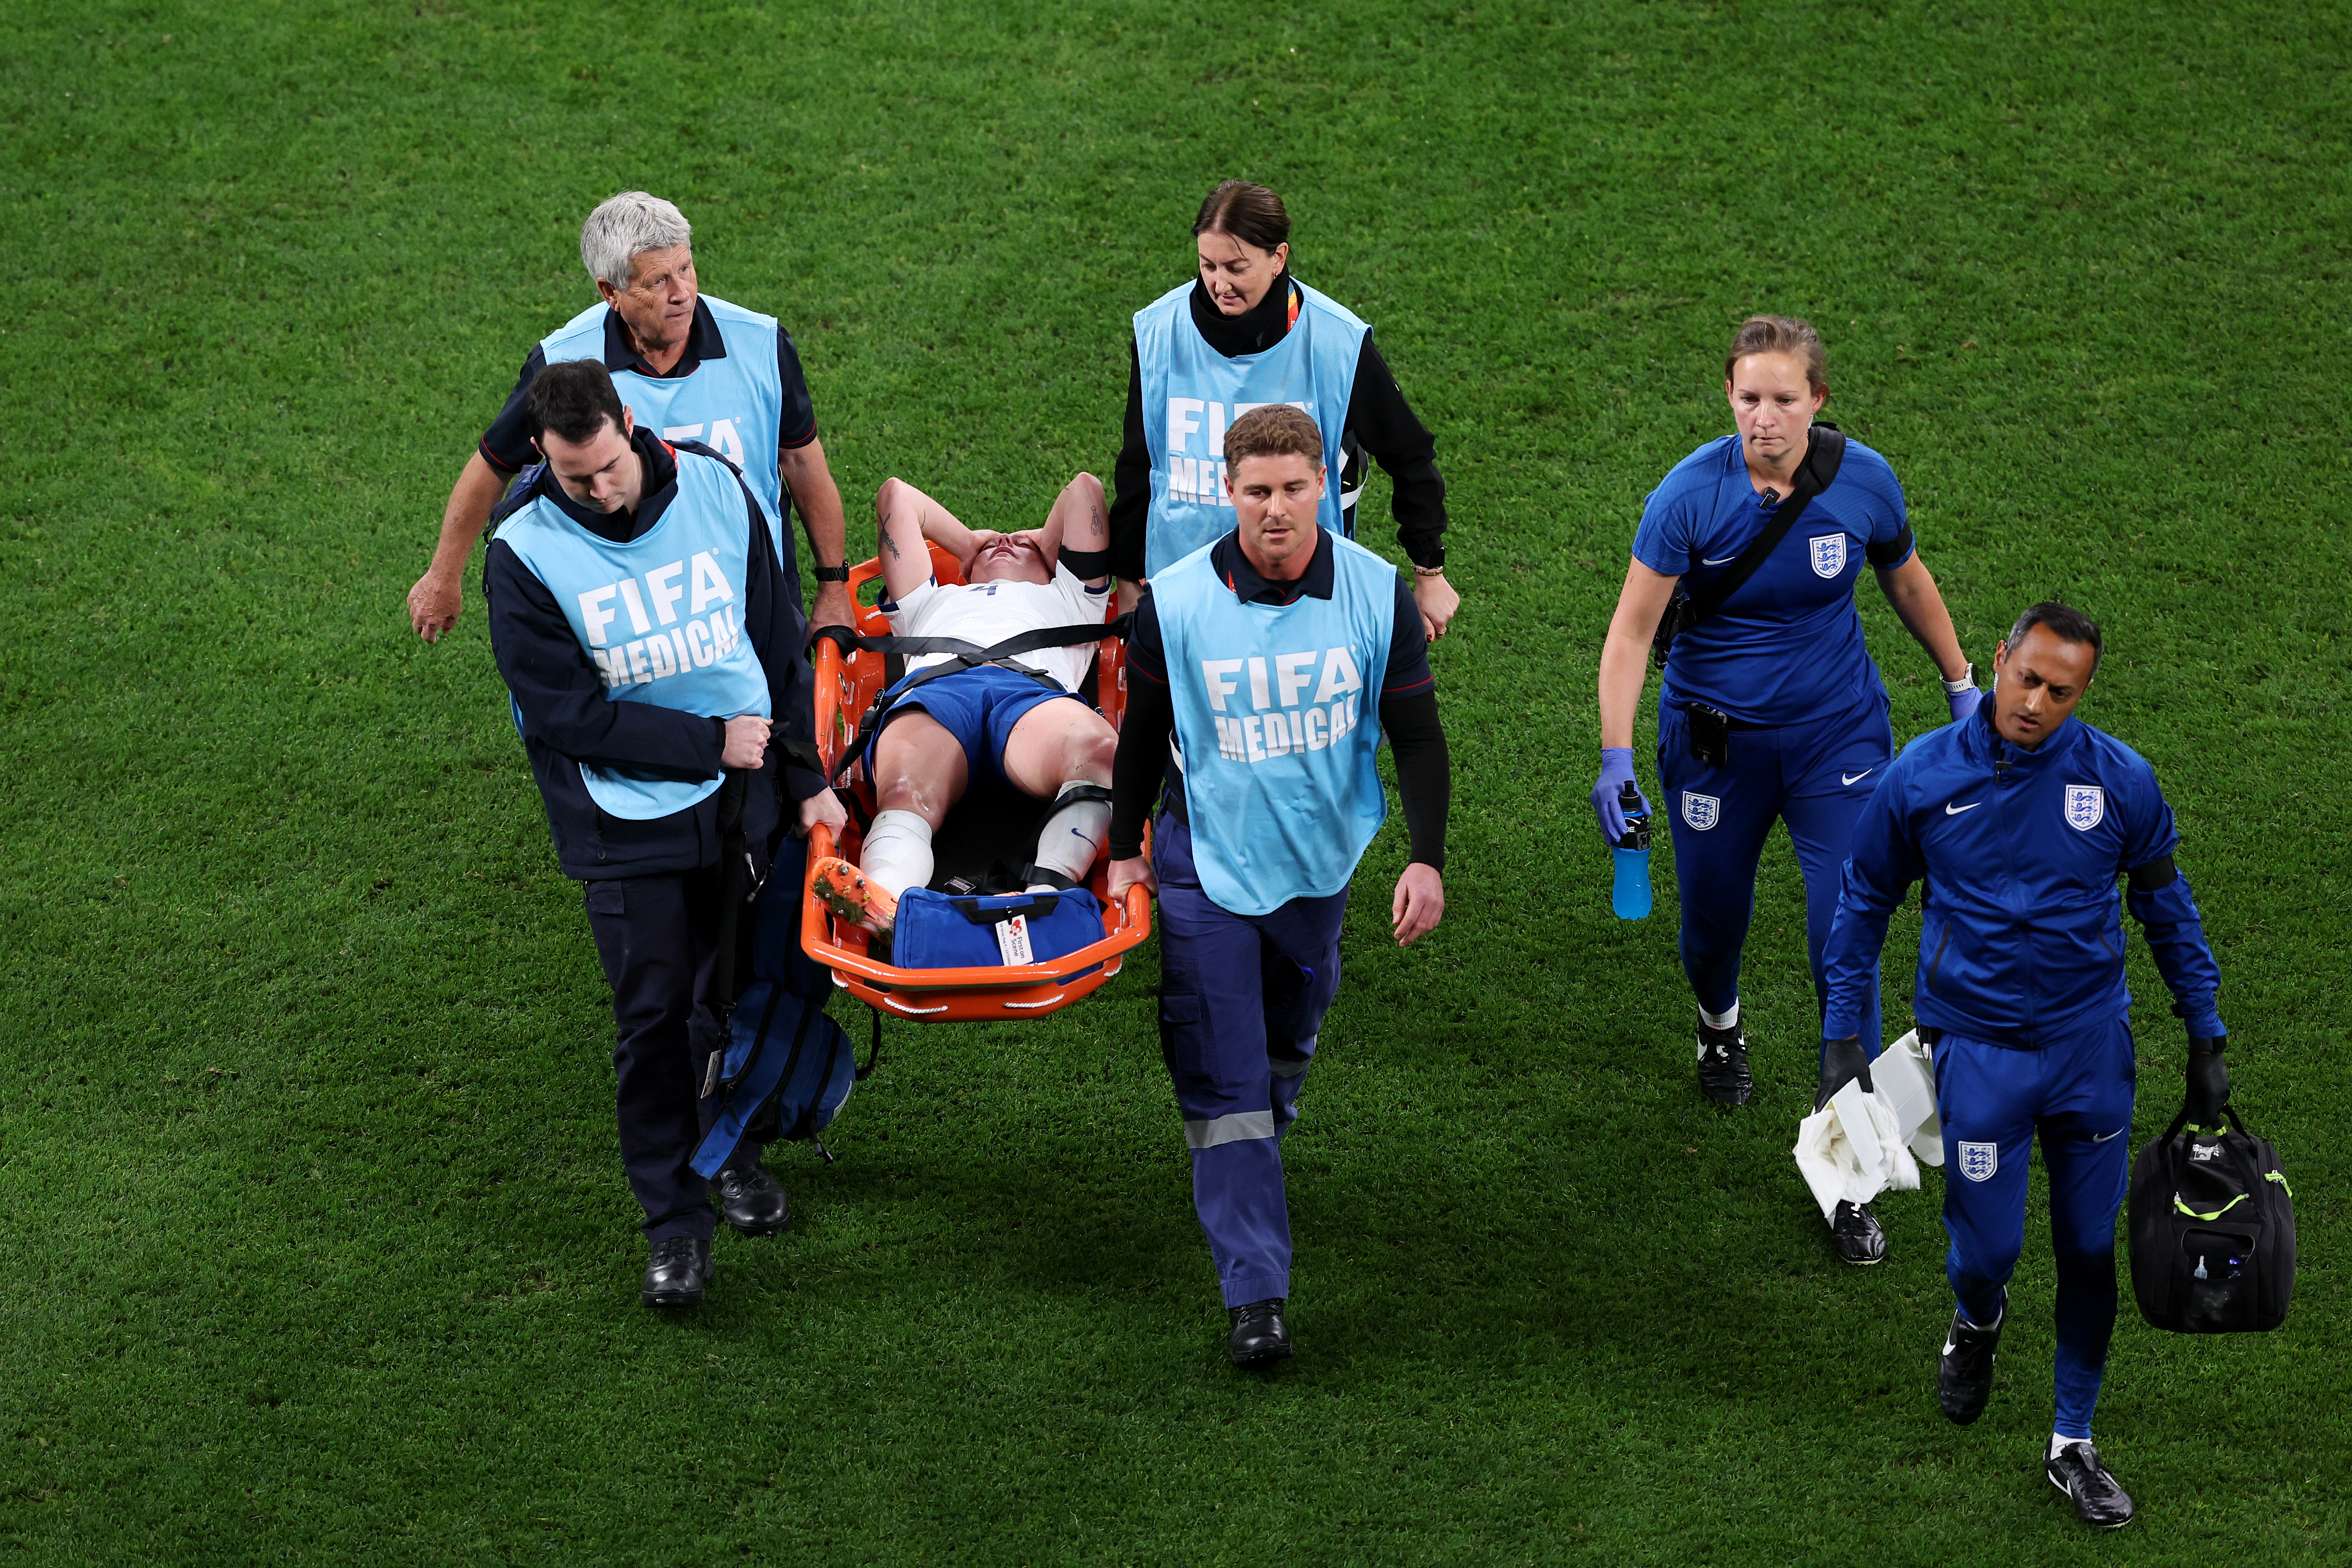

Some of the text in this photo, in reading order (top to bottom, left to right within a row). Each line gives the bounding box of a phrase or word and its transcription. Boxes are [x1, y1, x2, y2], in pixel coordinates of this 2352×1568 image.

[1168, 397, 1307, 456] FI
[577, 550, 734, 646] FIFA
[968, 585, 998, 596] 4
[593, 604, 739, 687] MEDICAL
[1202, 647, 1362, 711] FIFA
[1214, 693, 1357, 763] MEDICAL
